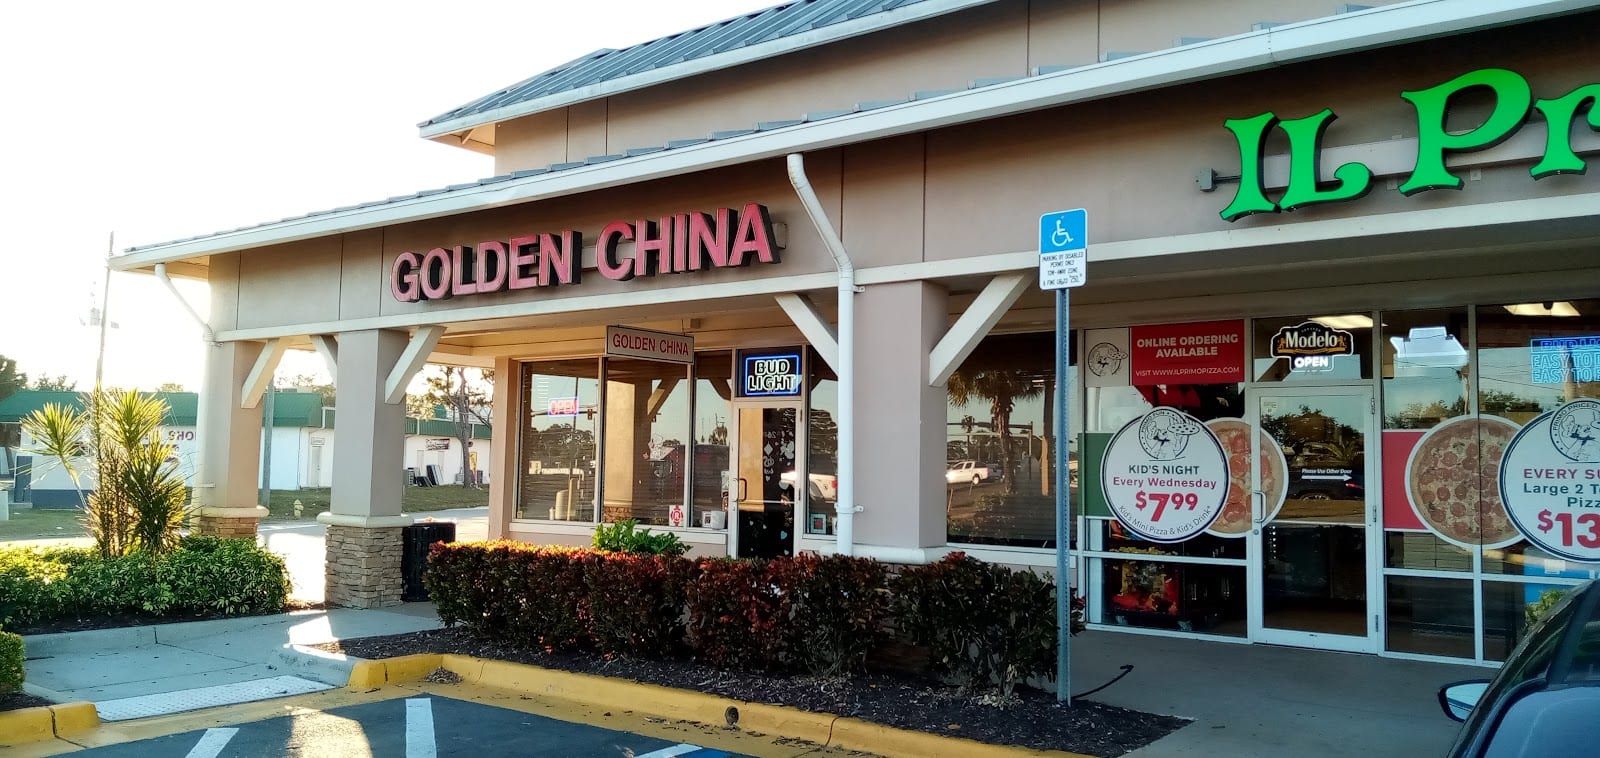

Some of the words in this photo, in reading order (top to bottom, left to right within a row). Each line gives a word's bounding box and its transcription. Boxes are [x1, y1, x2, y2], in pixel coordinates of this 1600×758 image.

[390, 231, 581, 302] GOLDEN
[596, 203, 780, 281] CHINA
[612, 333, 656, 352] GOLDEN
[659, 339, 689, 356] CHINA
[1136, 337, 1177, 348] ONLINE
[1179, 334, 1239, 346] ORDERING
[1285, 331, 1338, 349] Modelo
[1155, 346, 1218, 358] AVAILABLE
[755, 359, 790, 375] BUD
[1294, 356, 1329, 368] OPEN
[1152, 367, 1240, 376] WWW.ILPRIMOPIZZA.COM
[747, 374, 797, 391] LIGHT
[550, 400, 577, 415] OPEN
[168, 430, 196, 441] SHO
[1128, 465, 1159, 474] KID'S
[1162, 466, 1200, 475] NIGHT
[1523, 468, 1578, 479] EVERY
[1113, 477, 1144, 488] Every
[1147, 478, 1217, 490] Wednesday
[1523, 483, 1569, 496] Large
[1575, 484, 1584, 494] 2
[1567, 496, 1600, 508] Pizz
[1132, 519, 1149, 531] Mini
[1150, 526, 1168, 535] Pizza
[1177, 523, 1194, 534] Kid's
